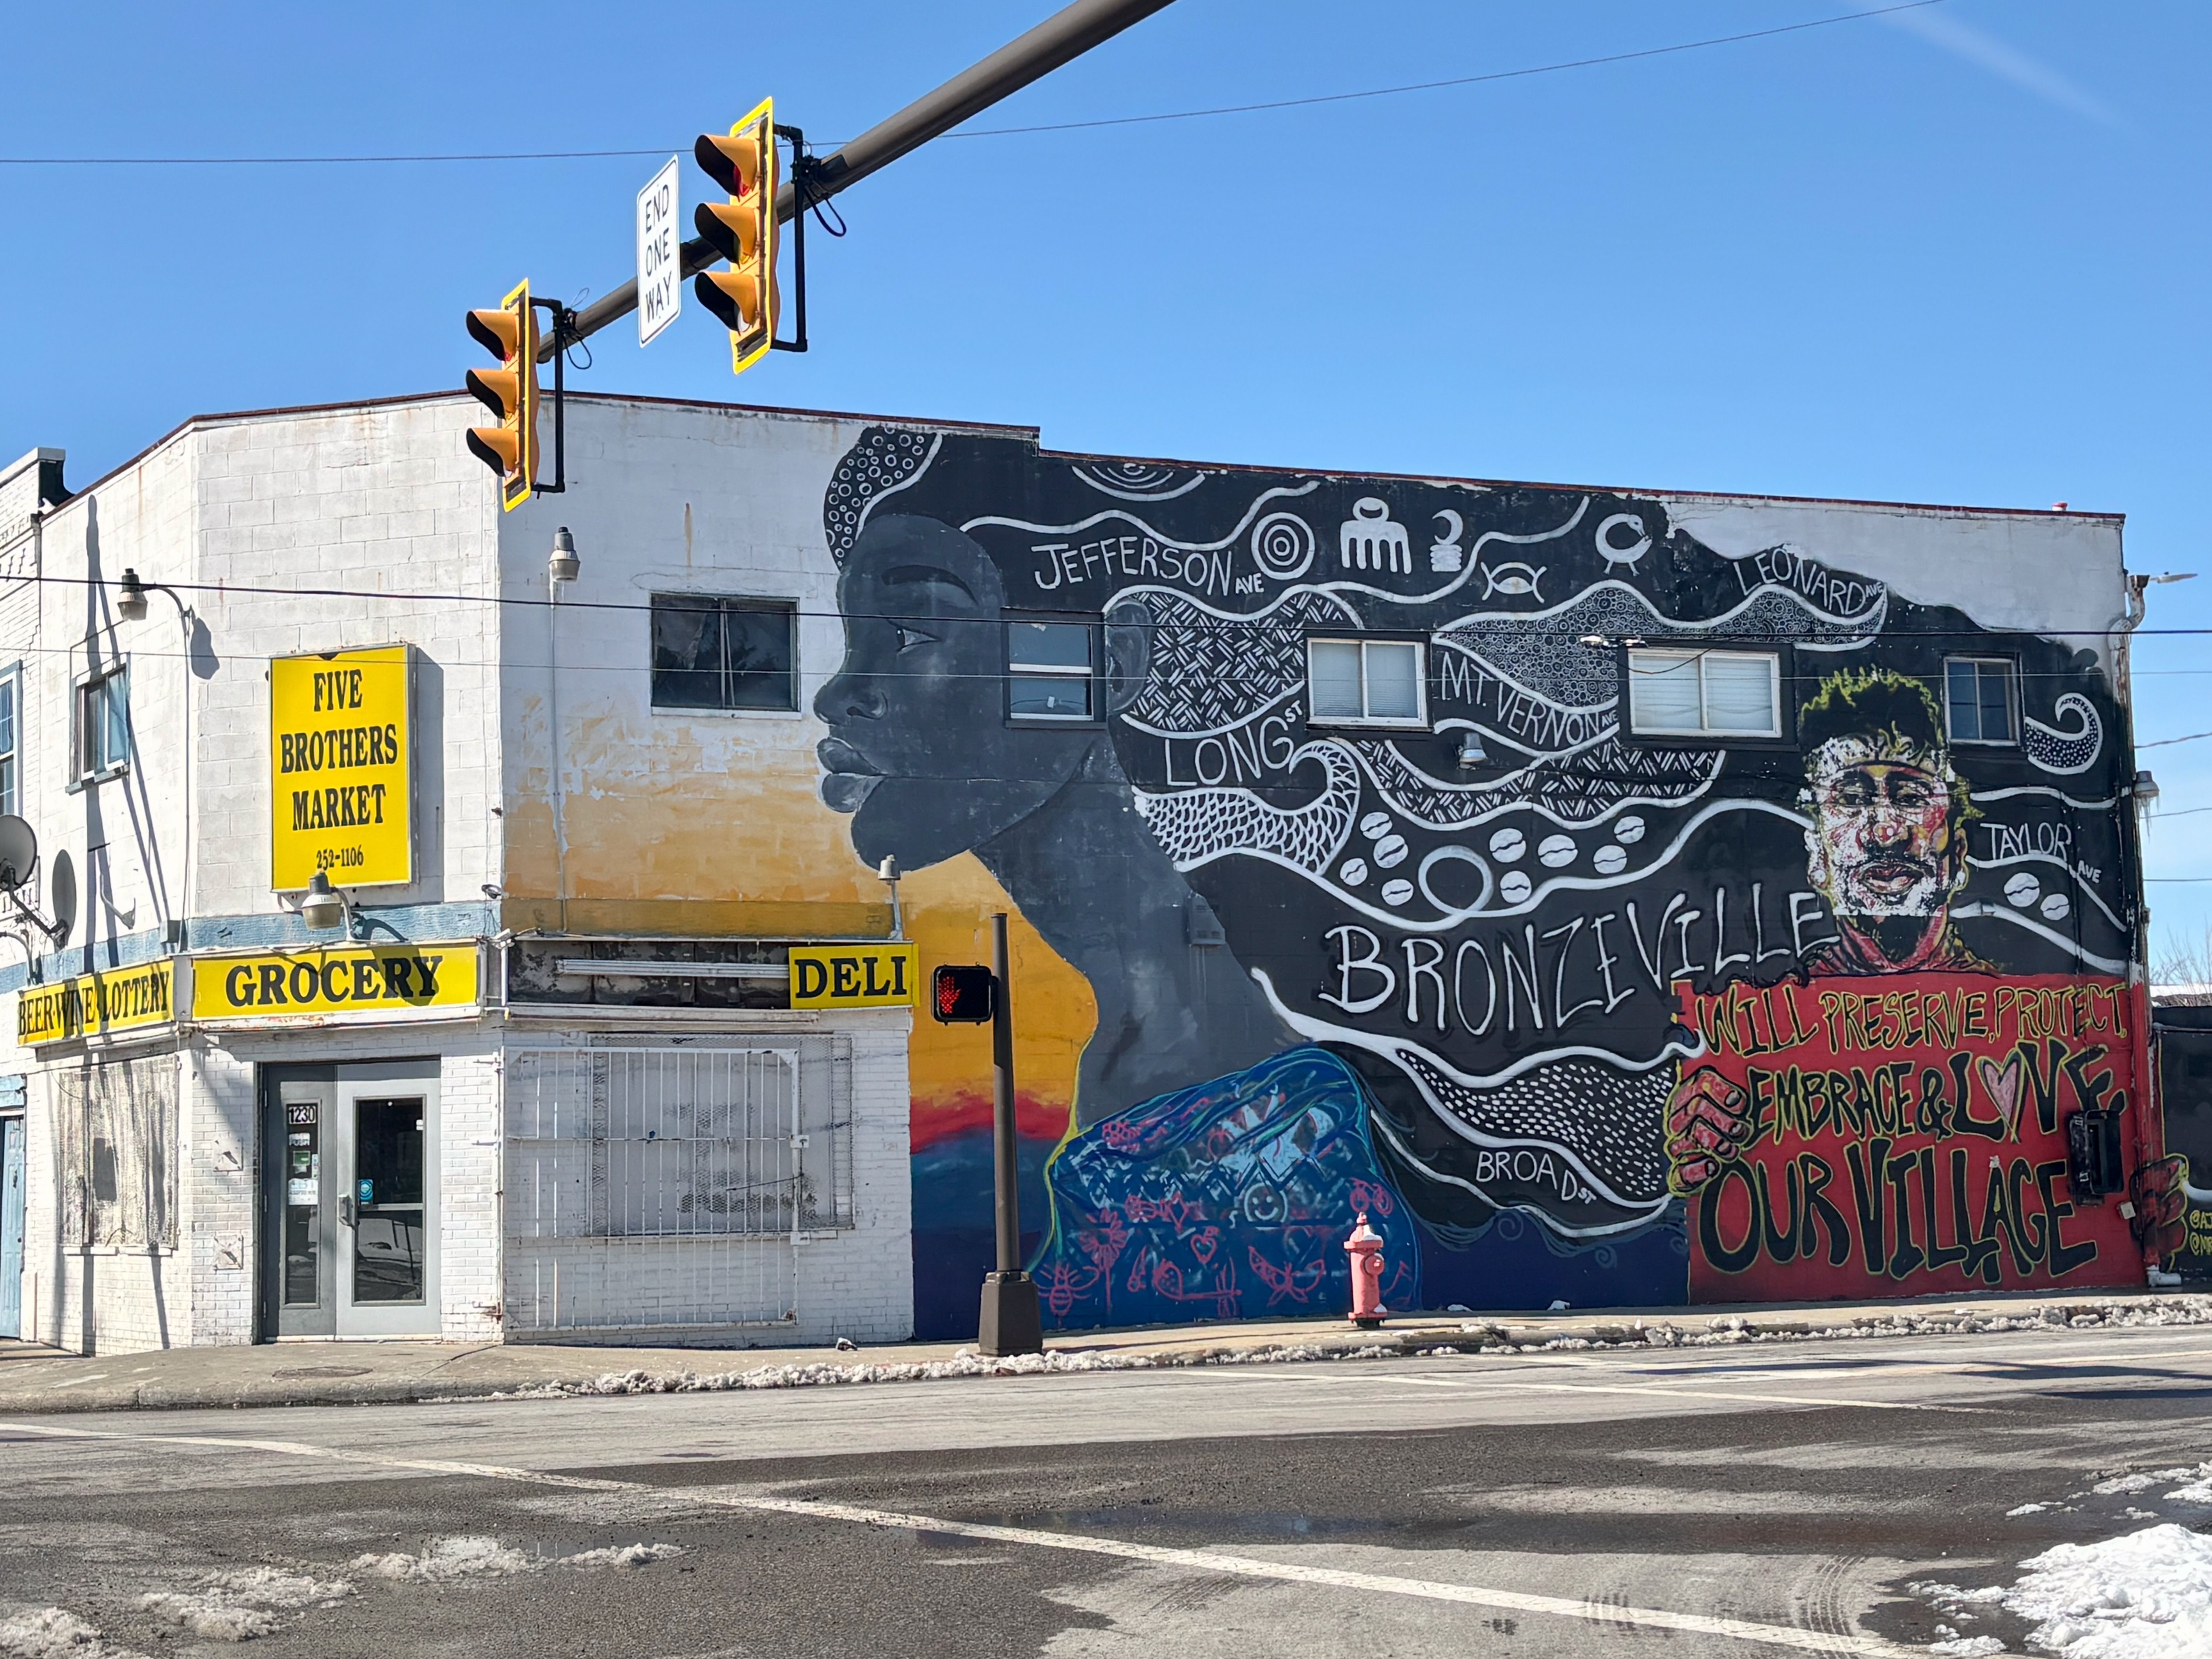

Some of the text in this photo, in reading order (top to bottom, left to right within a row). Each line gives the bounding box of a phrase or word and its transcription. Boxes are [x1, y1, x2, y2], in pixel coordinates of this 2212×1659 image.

[646, 184, 669, 234] END
[646, 227, 670, 277] ONE
[646, 270, 672, 323] WAY
[1031, 536, 1264, 596] JEFFERSON AVE
[1733, 548, 1885, 616] LEONARD AVE
[314, 669, 363, 712] FIVE
[1440, 651, 1619, 747] MT. VERNON AVE
[281, 724, 398, 773] BROTHERS
[1165, 700, 1303, 786] LONG ST
[292, 784, 386, 831] MARKET
[317, 845, 364, 871] 252-1106
[1980, 822, 2102, 884] TAYLOR AVE
[19, 971, 169, 1036] BEER WINE LOTTERY
[226, 956, 443, 1007] GROCERY
[794, 955, 908, 999] DELI
[1695, 984, 1819, 1059] WILL
[289, 1106, 315, 1123] 1230
[1746, 1061, 1915, 1149] EMBRACE
[1476, 1151, 1597, 1204] BROAD ST
[1698, 1136, 2098, 1285] OUR VILLAGE
